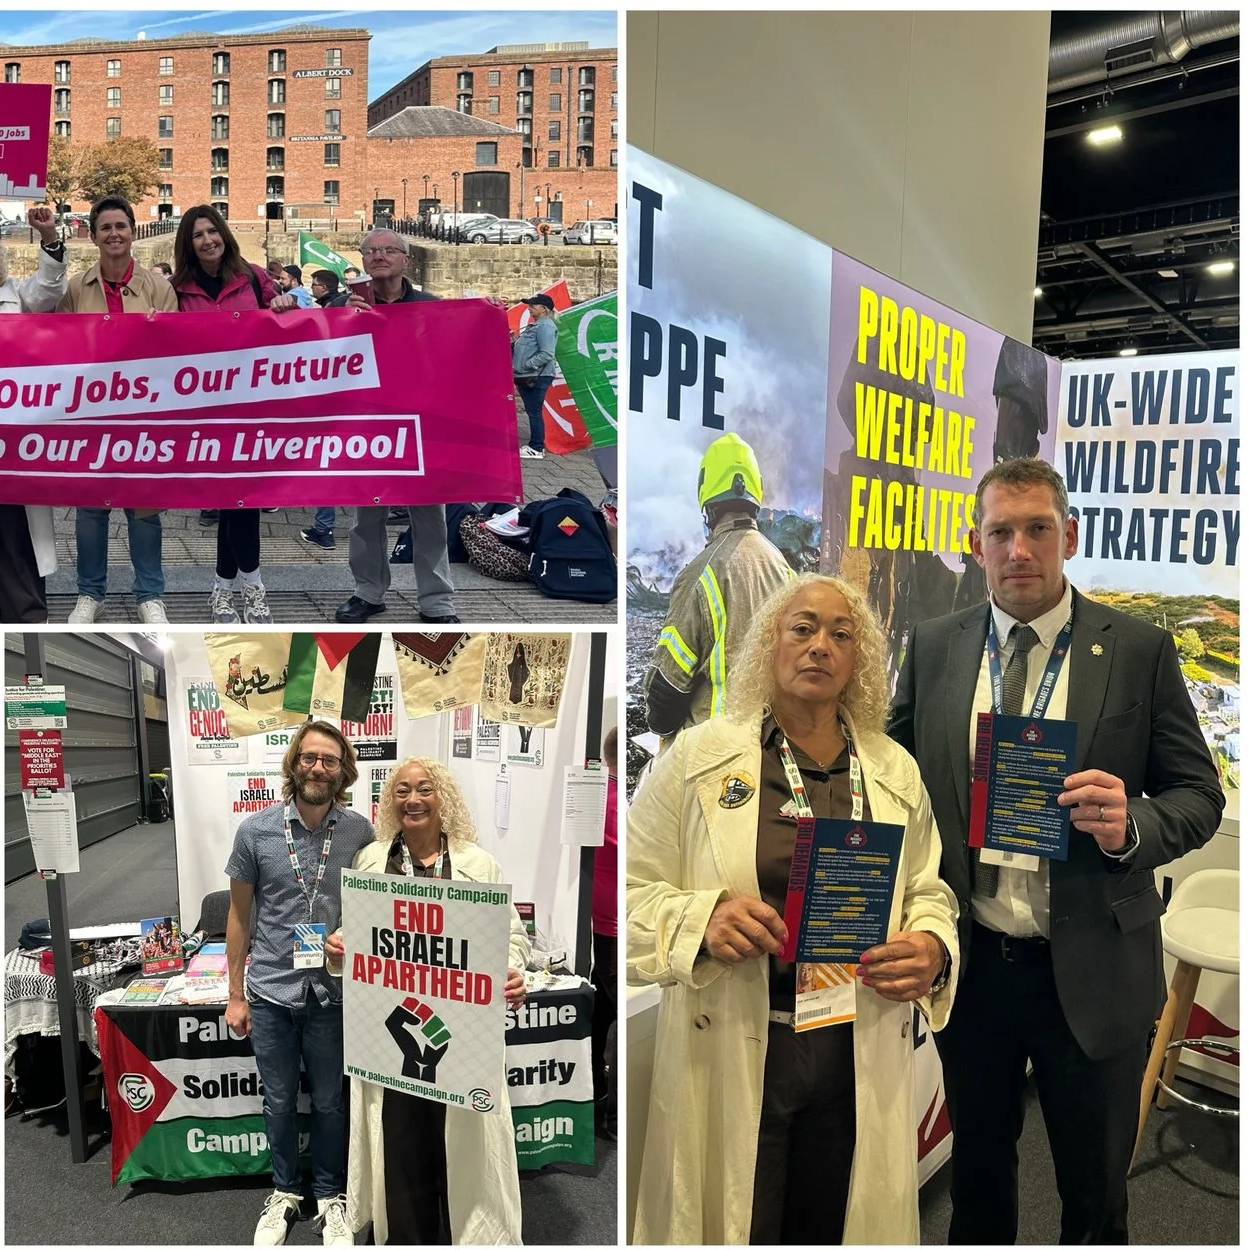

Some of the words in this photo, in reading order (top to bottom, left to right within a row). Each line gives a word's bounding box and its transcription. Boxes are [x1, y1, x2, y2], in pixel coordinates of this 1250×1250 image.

[5, 129, 25, 138] Jobs
[857, 286, 966, 398] PROPER
[65, 371, 160, 413] Jobs,
[174, 366, 241, 395] Our
[250, 352, 364, 388] Future
[628, 311, 727, 431] PPE
[1067, 366, 1235, 428] UK-WIDE
[18, 434, 87, 462] Our
[89, 432, 176, 470] Jobs
[186, 430, 221, 462] in
[231, 427, 407, 468] Liverpool
[854, 382, 976, 479] WELFARE
[1065, 438, 1240, 494] WILDFIRE
[848, 475, 976, 554] FACILITES
[188, 689, 220, 710] END
[240, 789, 274, 800] ISRAELI
[248, 778, 266, 789] END
[343, 875, 388, 893] Palestine
[391, 882, 444, 900] Solidarity
[447, 886, 508, 905] Campaign
[394, 900, 444, 935] END
[372, 927, 468, 970] ISRAELI
[352, 953, 492, 1006] APARTHEID
[347, 1064, 464, 1105] www.palestinecampaign.org
[472, 1095, 490, 1106] PSC
